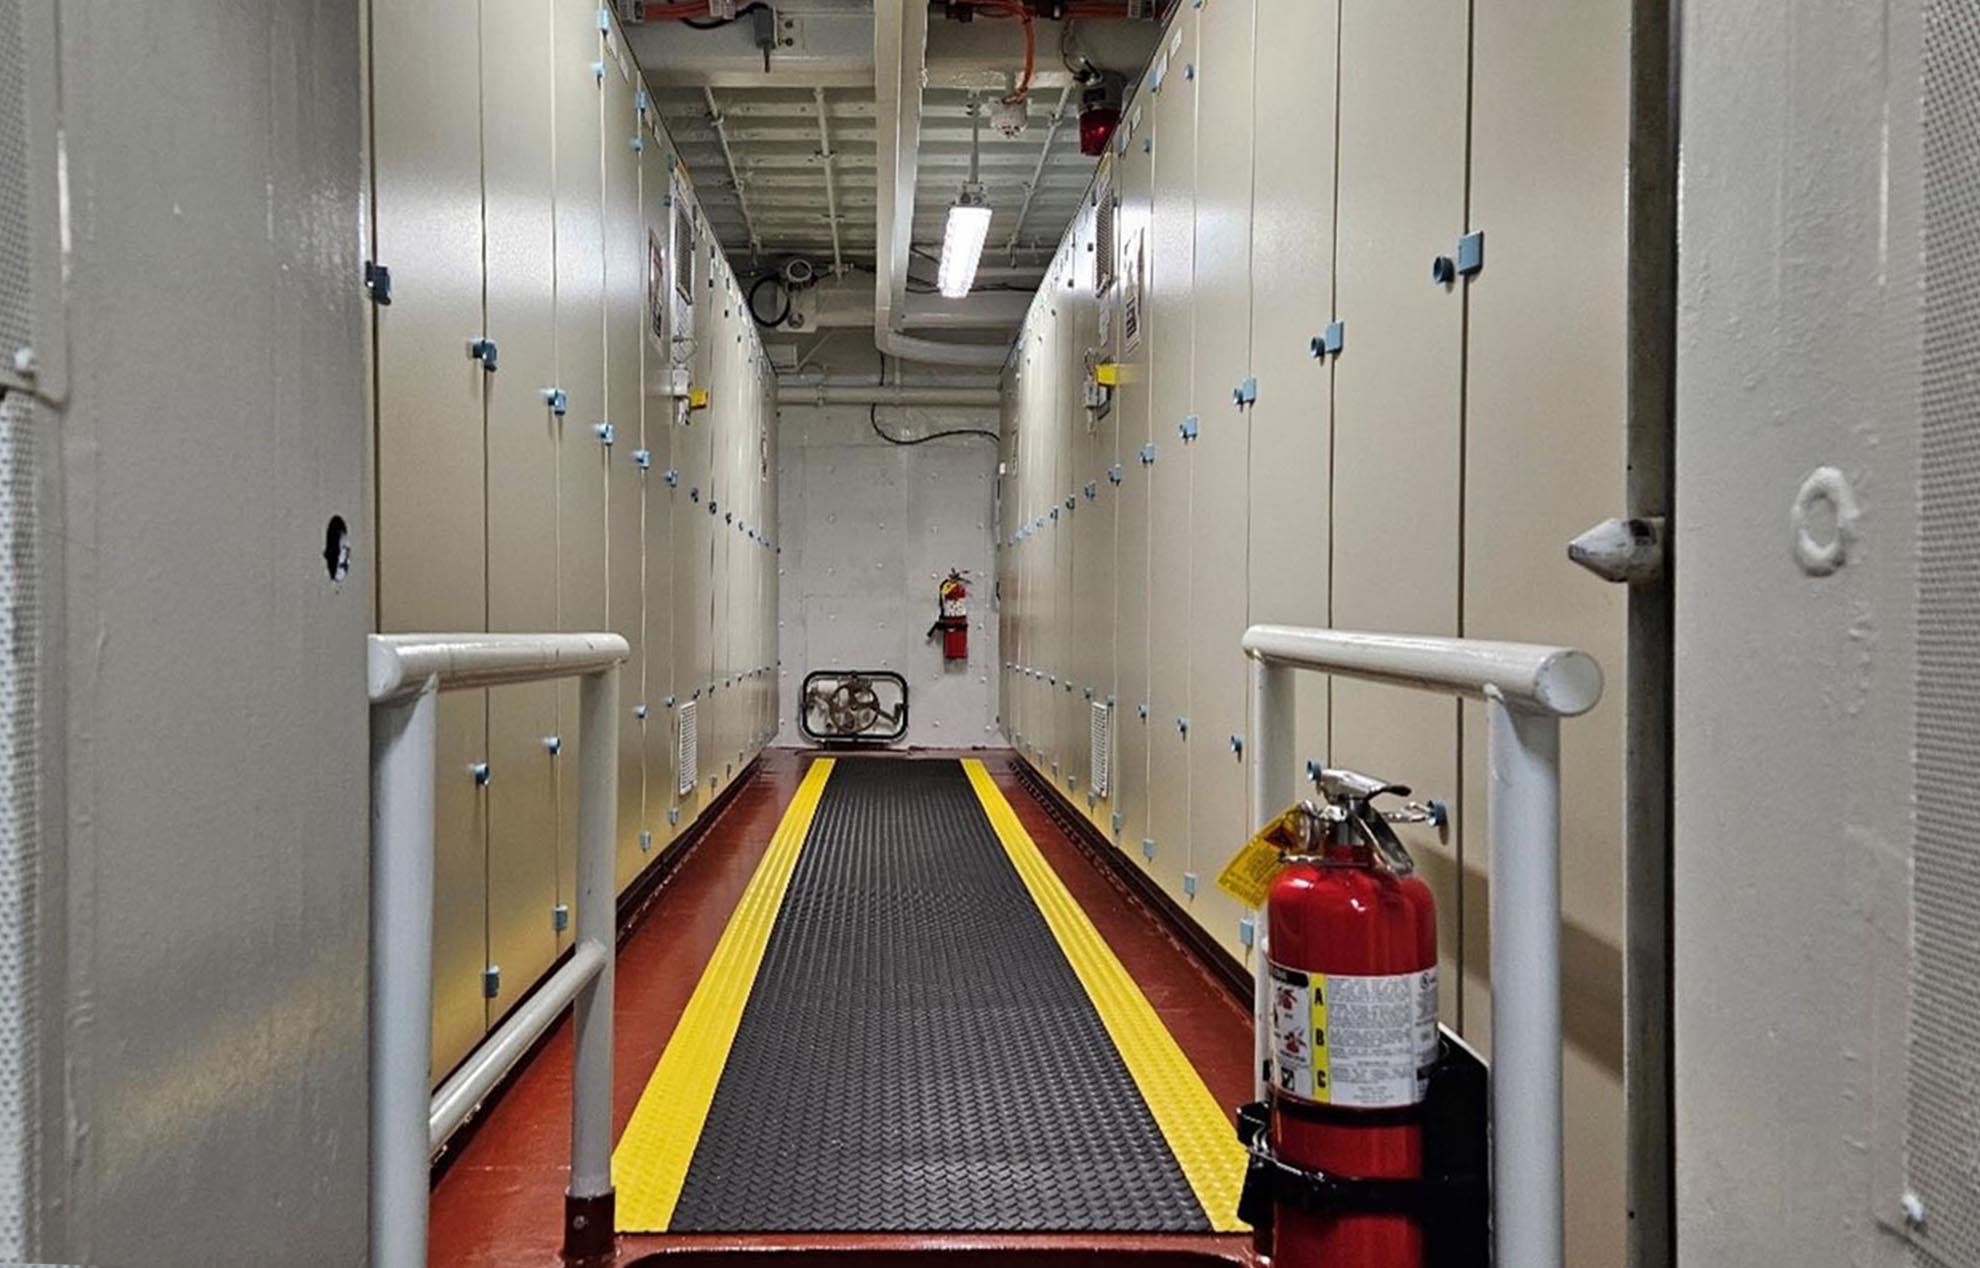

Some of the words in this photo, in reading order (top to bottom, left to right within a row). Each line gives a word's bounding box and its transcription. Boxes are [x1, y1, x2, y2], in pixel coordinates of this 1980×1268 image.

[1314, 987, 1325, 1006] A
[1315, 1028, 1325, 1046] B
[1317, 1069, 1327, 1088] C
